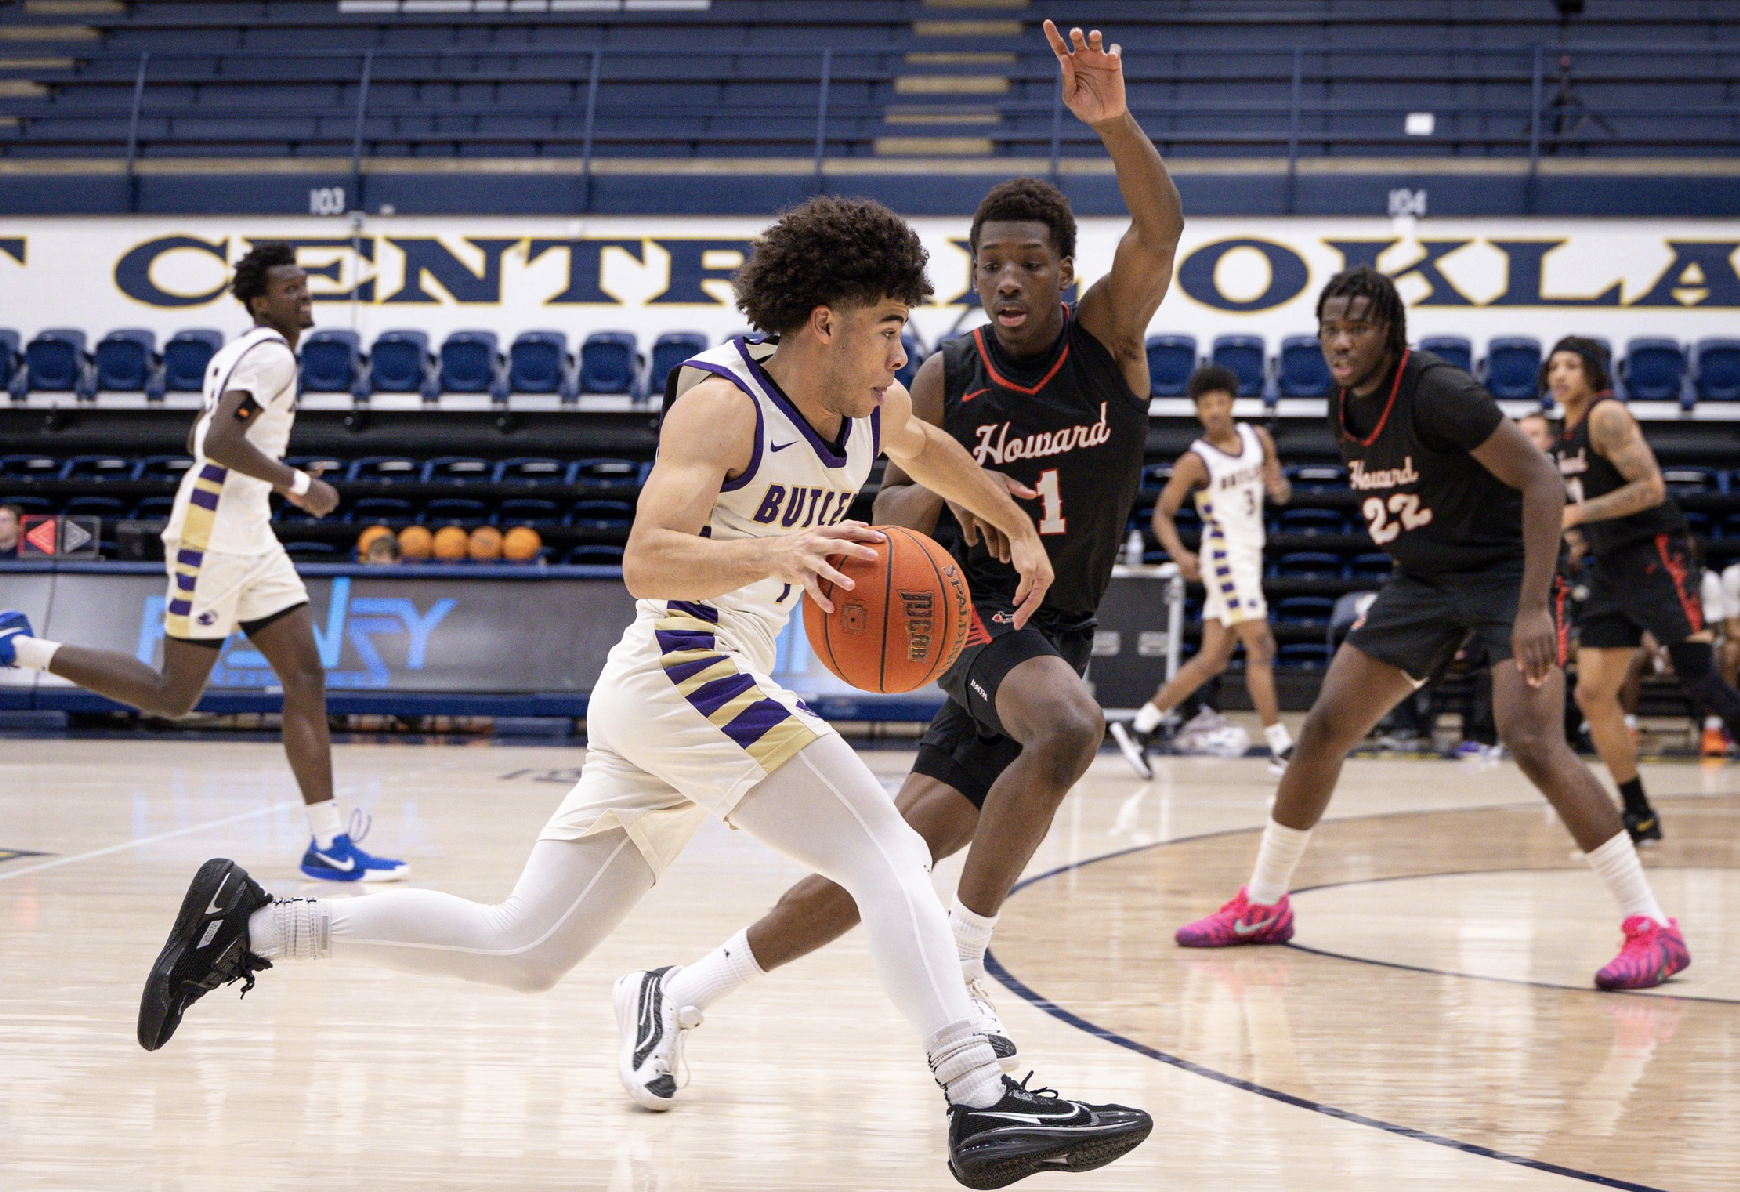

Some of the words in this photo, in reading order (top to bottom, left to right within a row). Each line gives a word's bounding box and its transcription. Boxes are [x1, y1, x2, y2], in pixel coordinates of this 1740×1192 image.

[309, 187, 346, 215] 103
[1388, 187, 1428, 216] 104
[973, 400, 1112, 466] Howard
[750, 482, 861, 531] BUTLE
[1034, 467, 1068, 536] 1
[1362, 492, 1433, 545] 22
